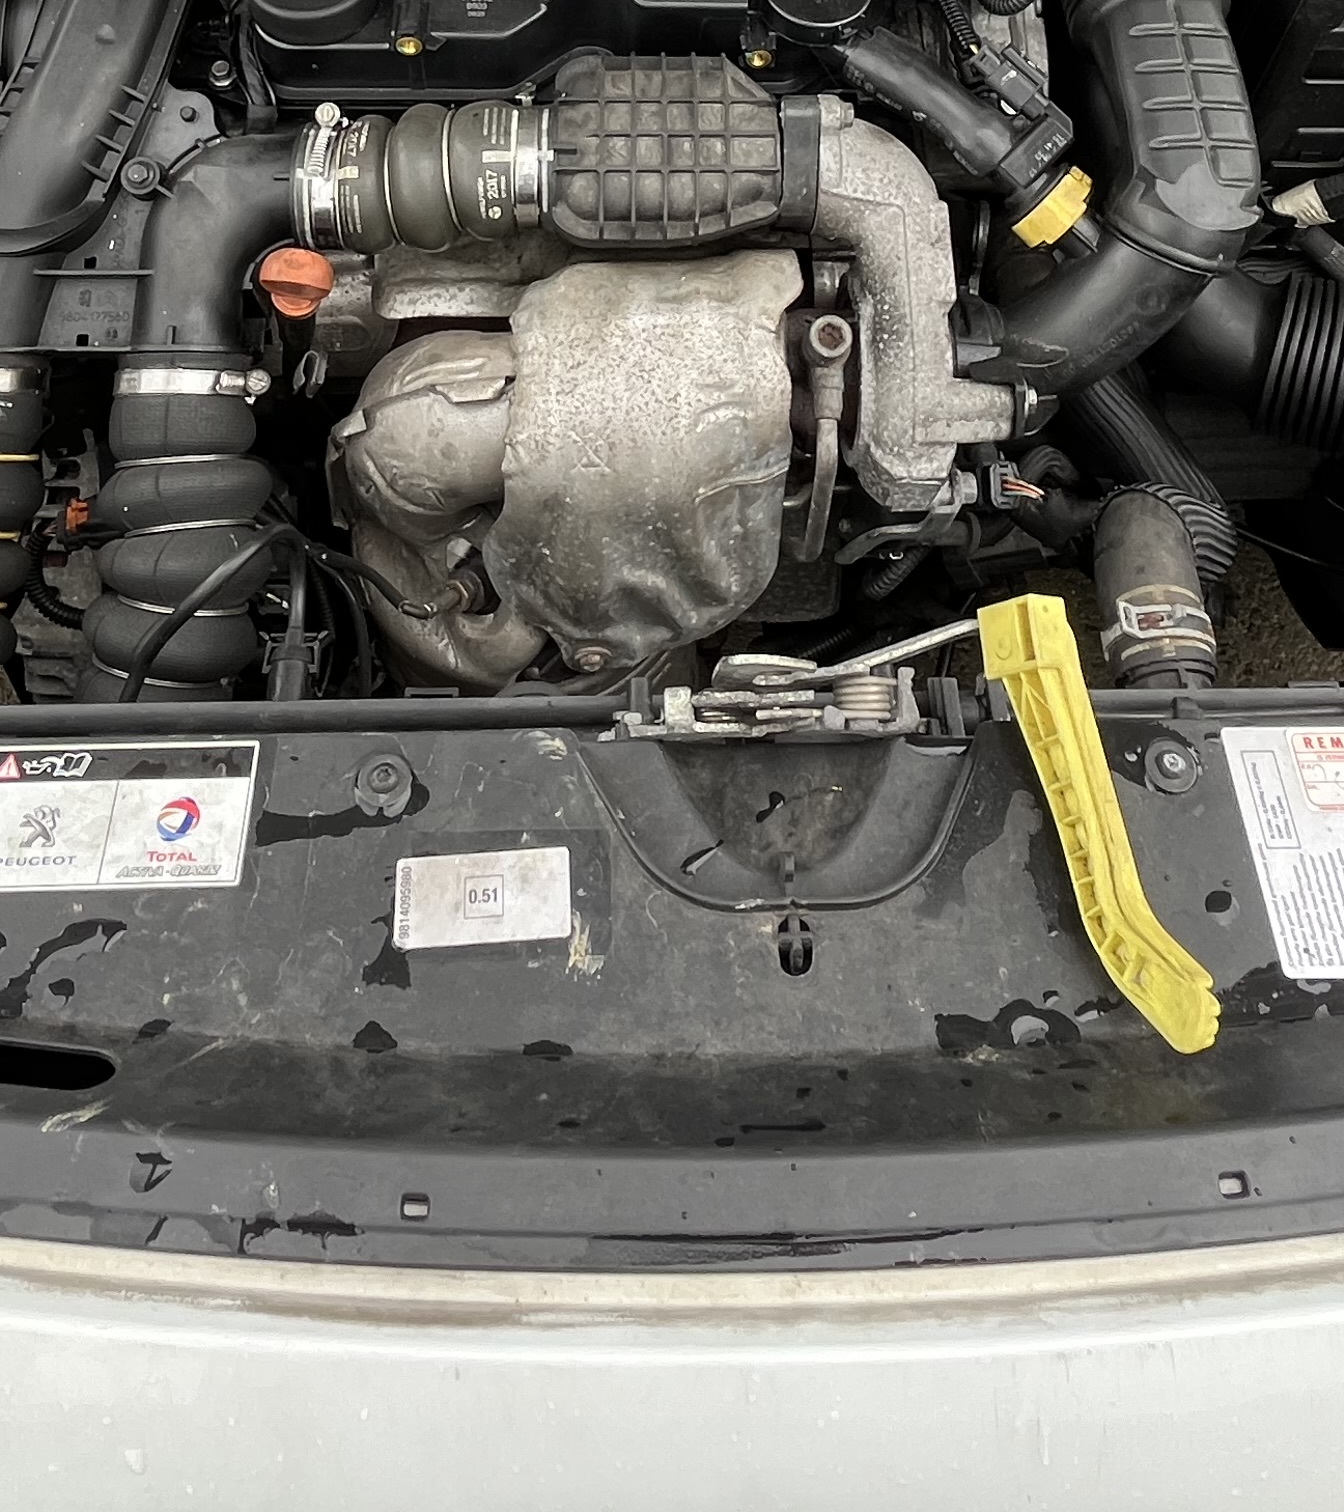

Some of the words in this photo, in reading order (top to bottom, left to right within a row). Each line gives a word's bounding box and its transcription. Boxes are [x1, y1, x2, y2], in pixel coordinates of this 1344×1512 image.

[485, 169, 500, 200] 2017
[398, 865, 412, 940] 9814095980
[468, 887, 498, 904] 0.51
